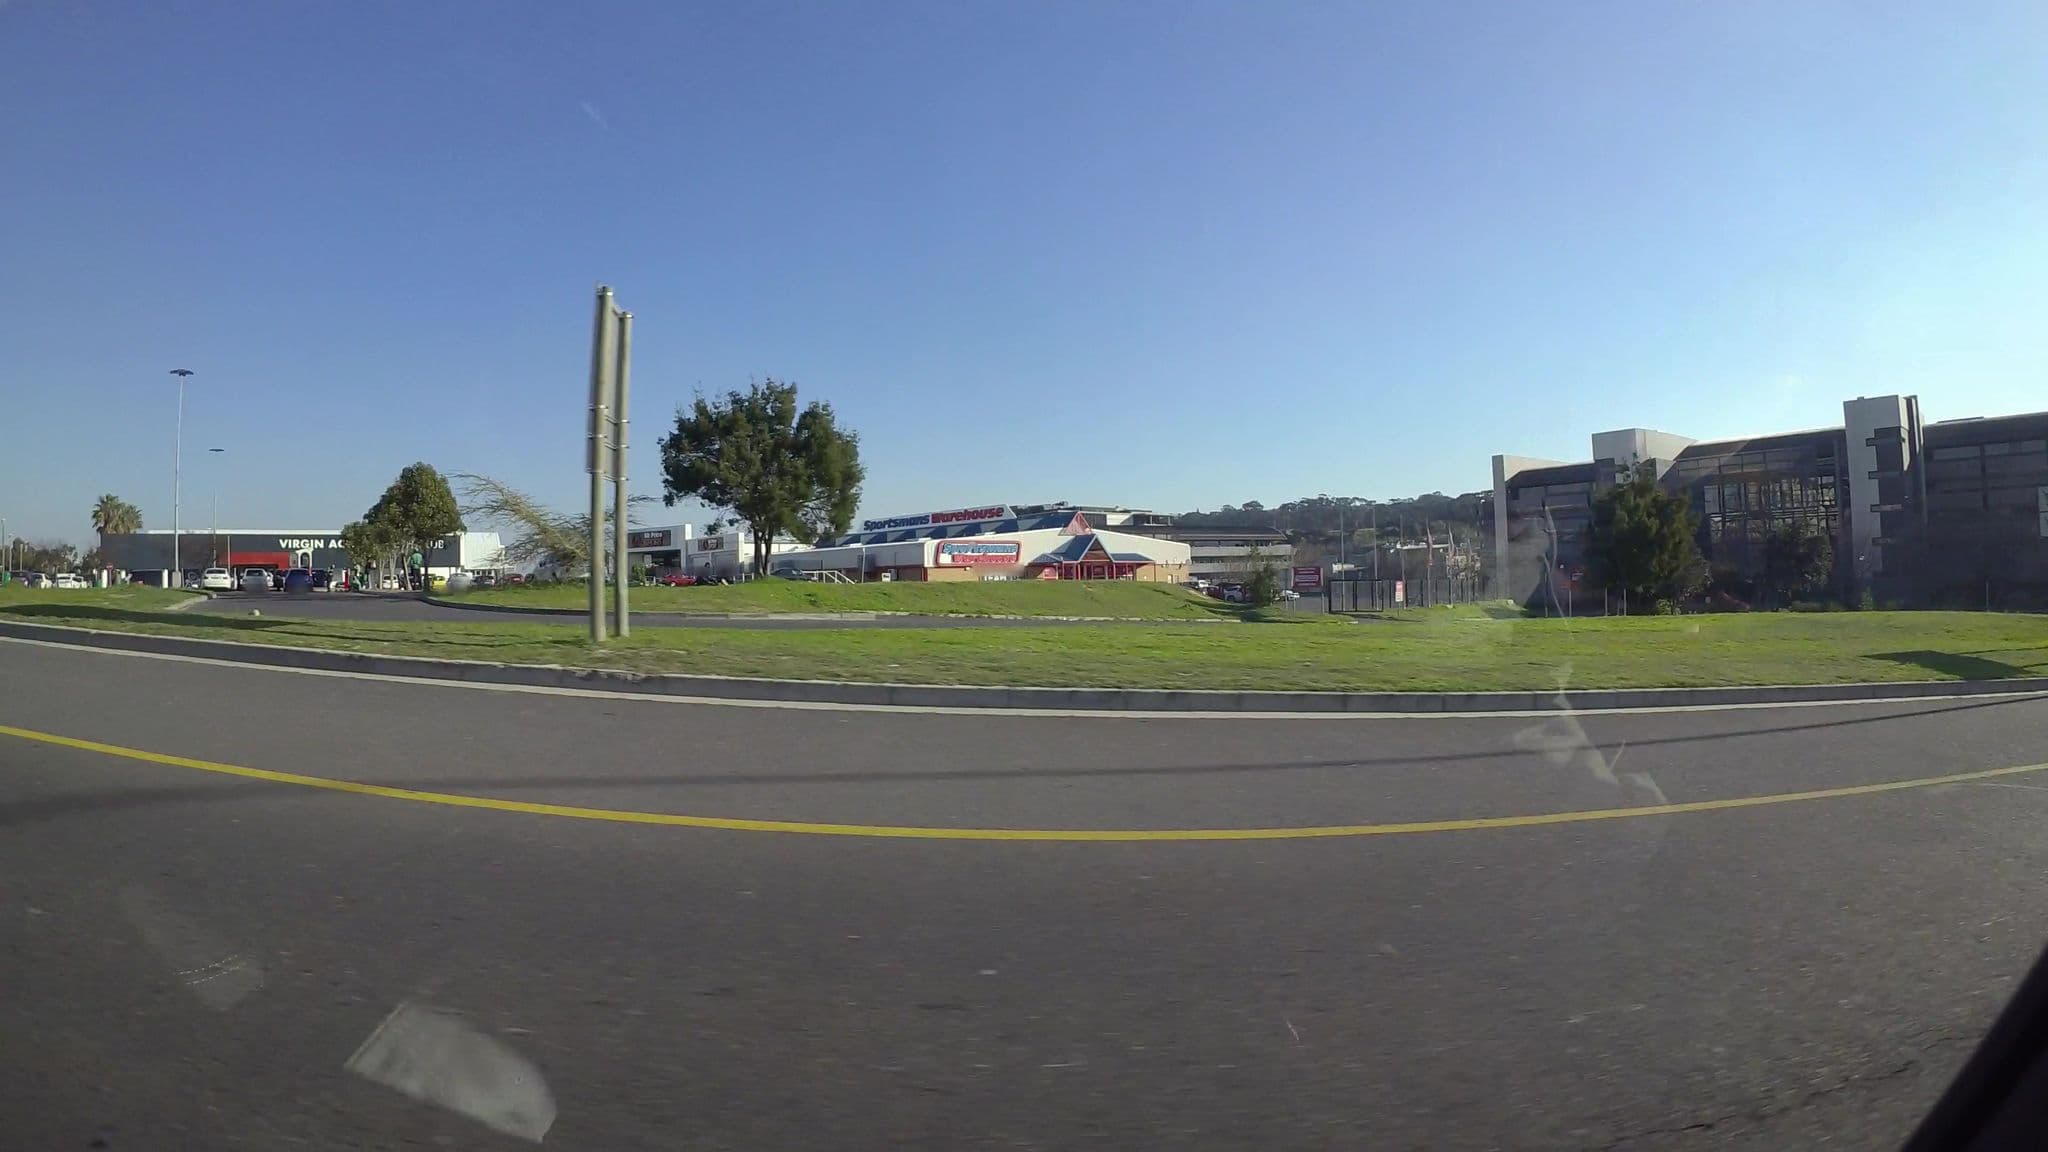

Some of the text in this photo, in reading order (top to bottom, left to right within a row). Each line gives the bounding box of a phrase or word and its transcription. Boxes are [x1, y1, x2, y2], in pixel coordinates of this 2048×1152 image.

[863, 507, 1005, 531] Sportsmans Warehouse
[279, 538, 325, 549] VIRGIN
[328, 538, 345, 549] AC
